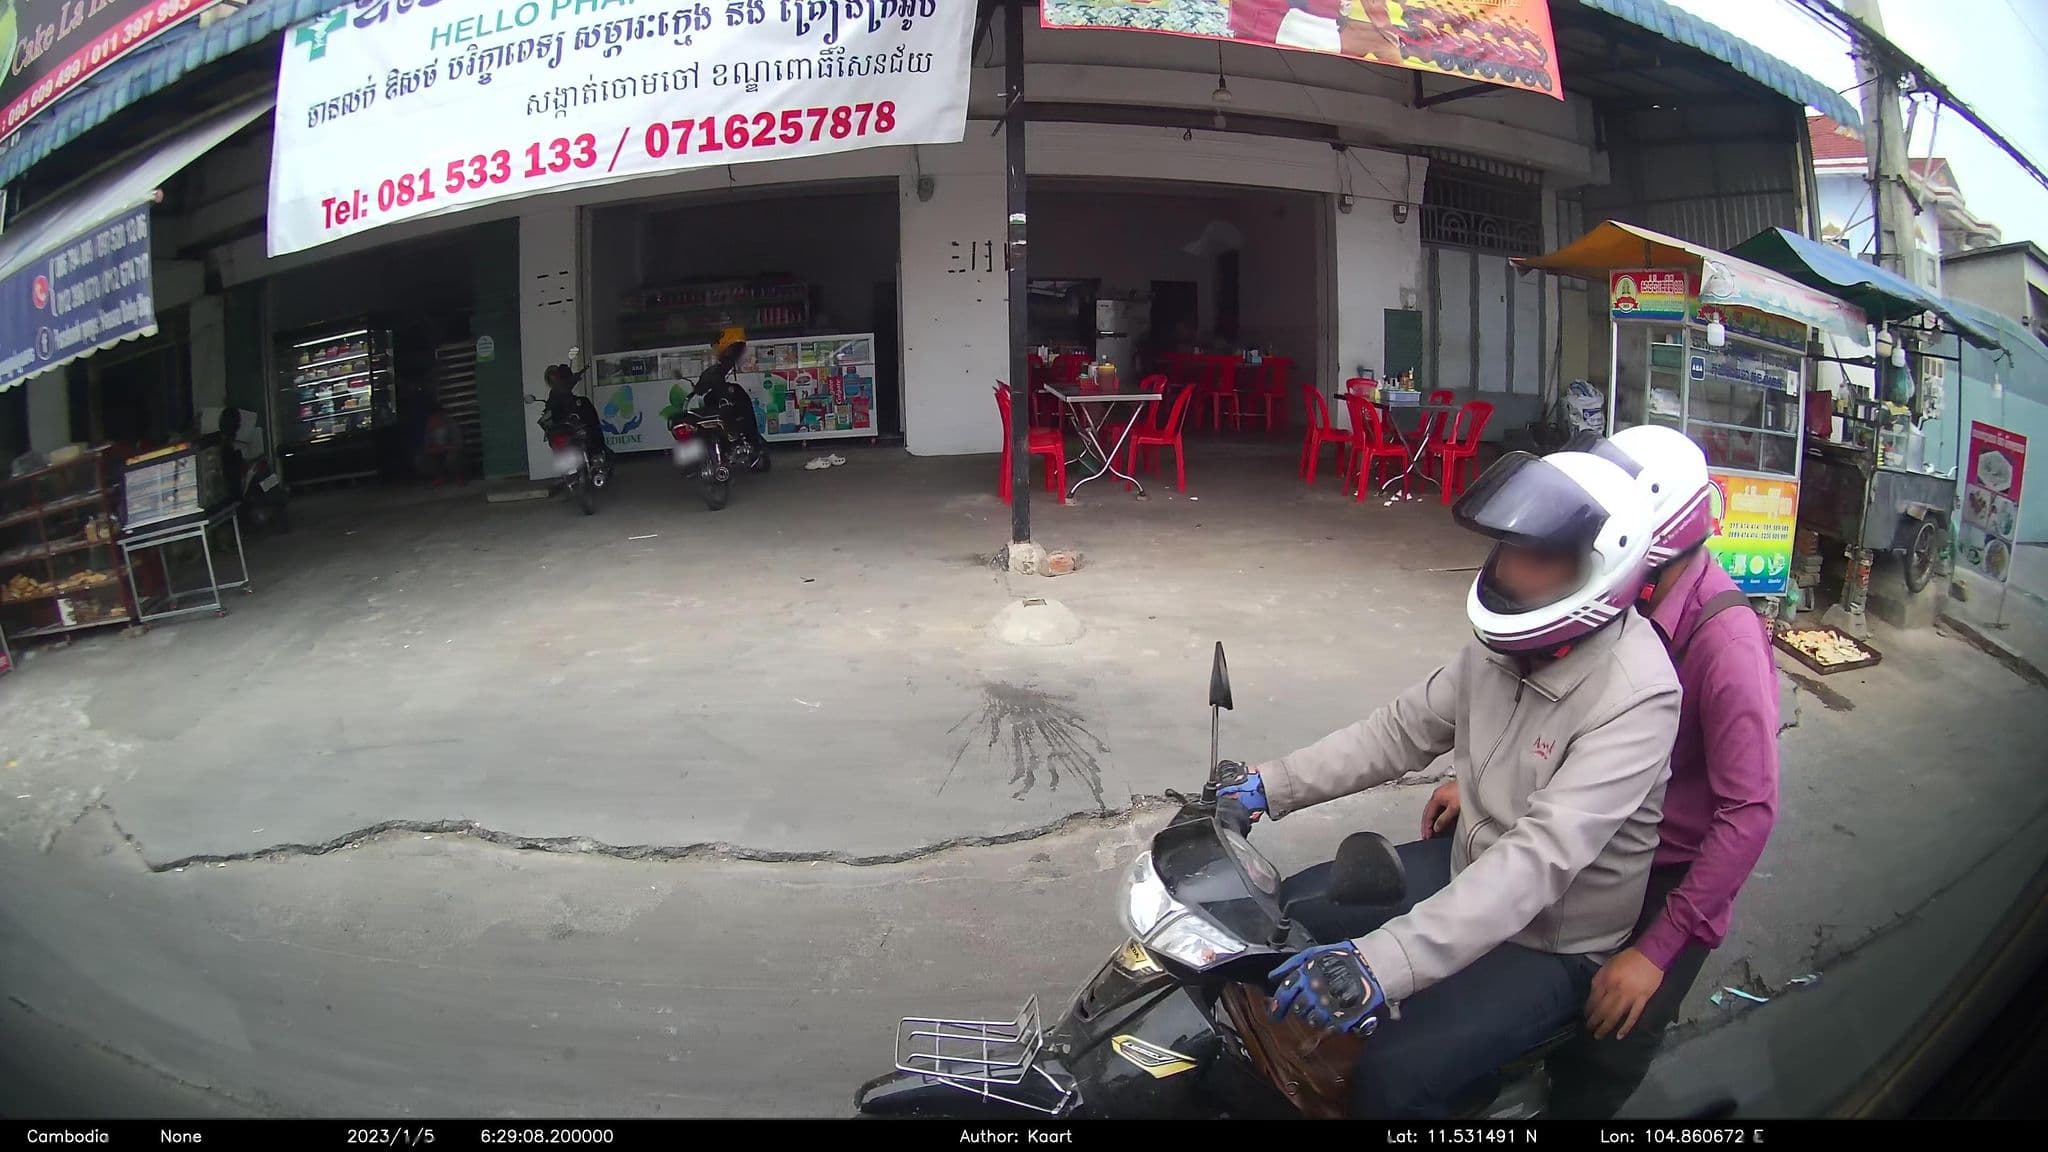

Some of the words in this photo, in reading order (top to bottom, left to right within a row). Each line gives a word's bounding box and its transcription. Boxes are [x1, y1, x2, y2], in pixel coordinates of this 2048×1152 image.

[12, 22, 55, 76] Cake
[431, 2, 540, 50] HELLO
[550, 0, 635, 20] PH
[321, 189, 368, 230] Tel:
[378, 167, 435, 213] 081
[445, 149, 511, 194] 533
[524, 133, 597, 178] 133
[607, 127, 630, 173] /
[645, 100, 896, 159] 0716257878
[605, 434, 642, 446] EDICINE
